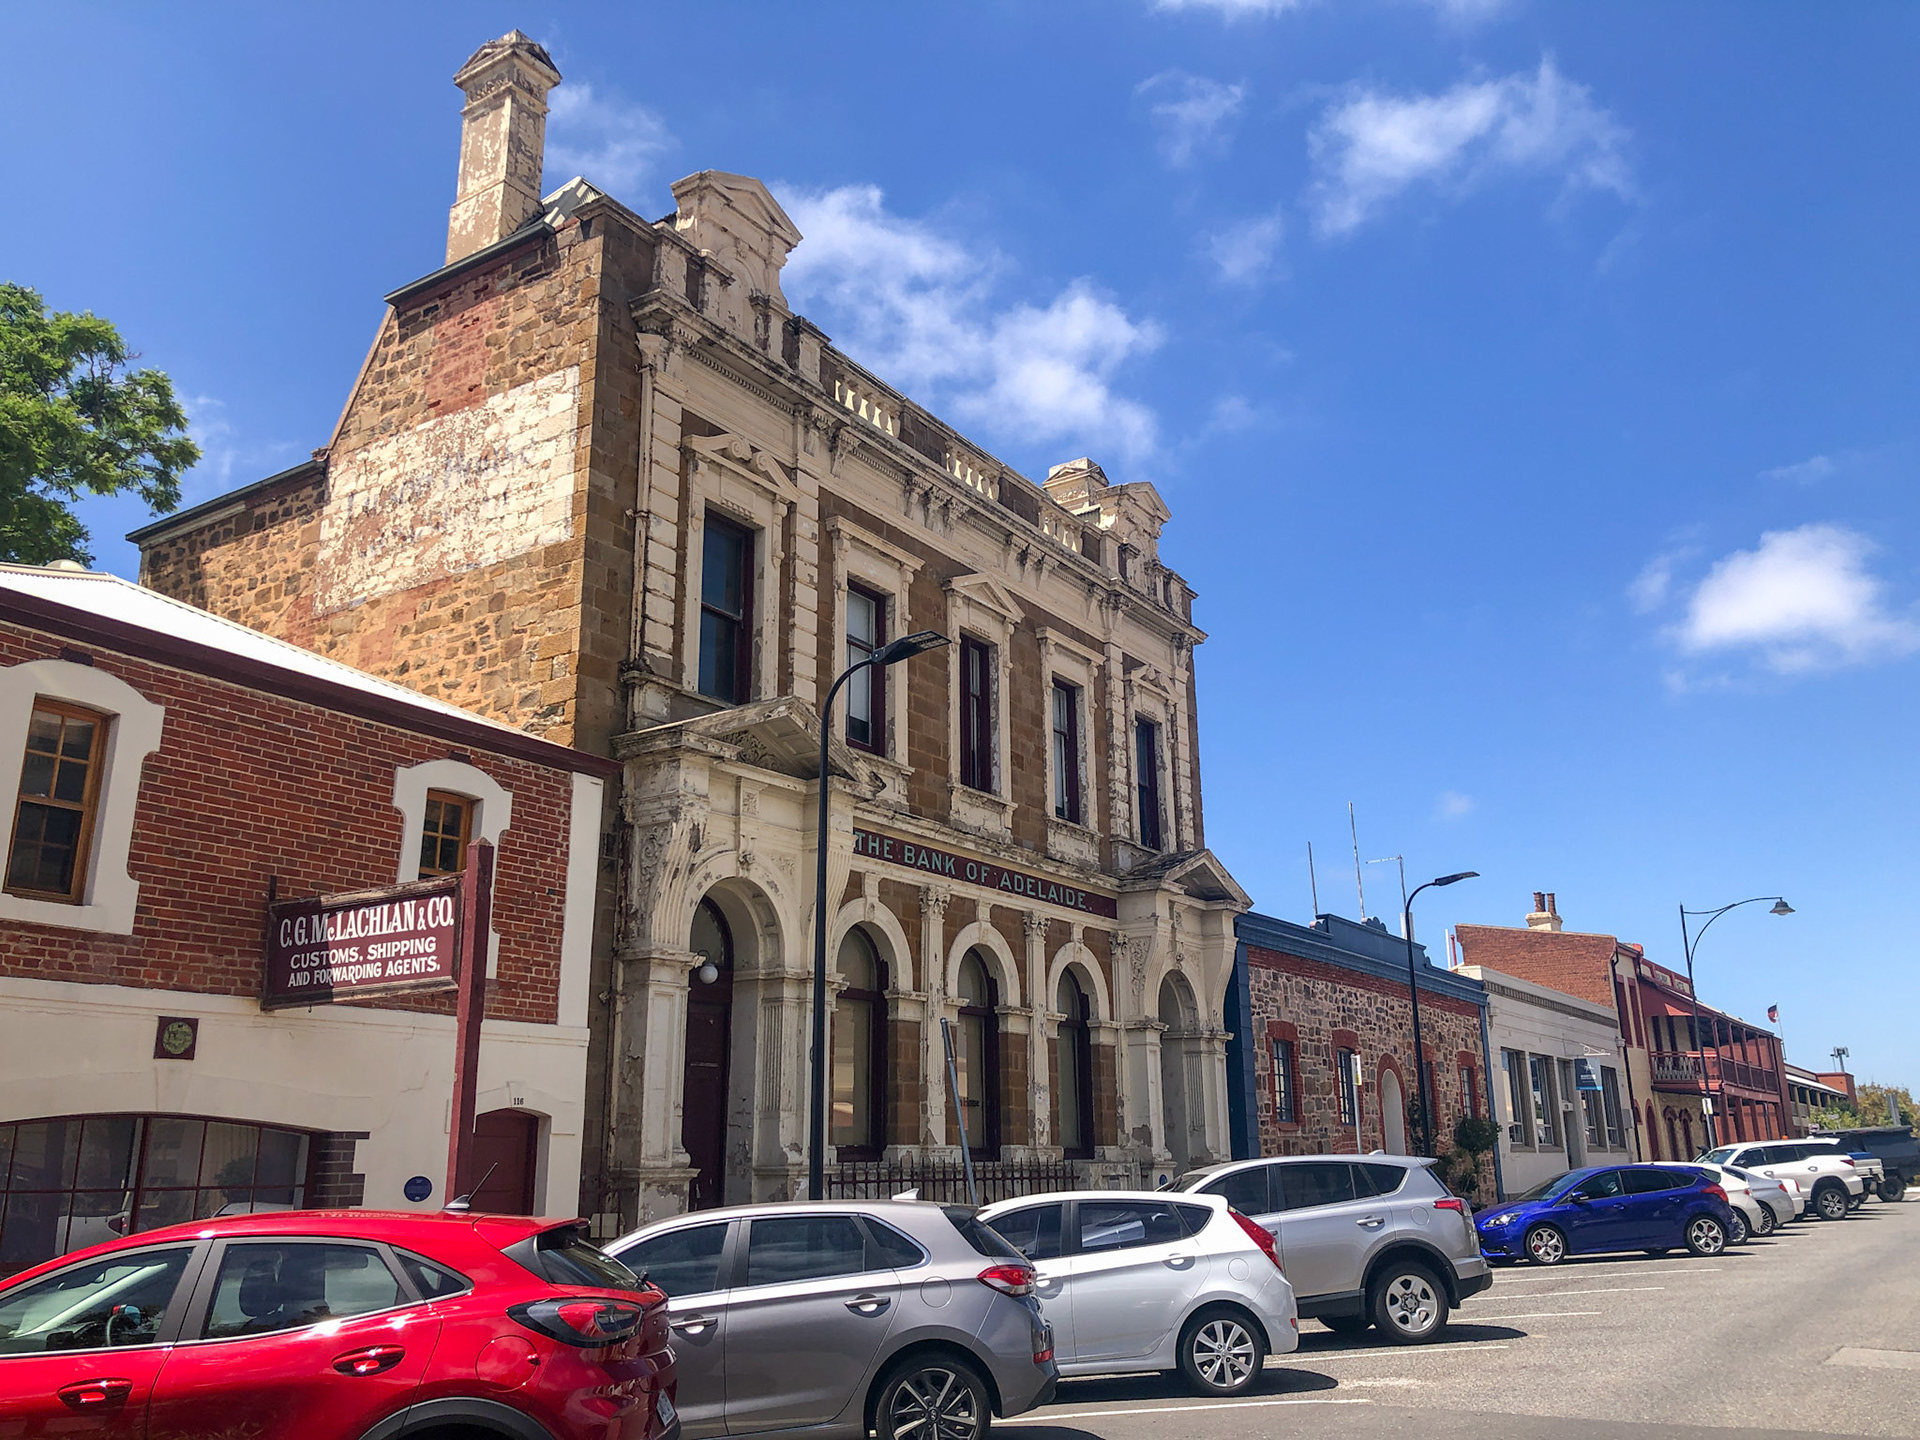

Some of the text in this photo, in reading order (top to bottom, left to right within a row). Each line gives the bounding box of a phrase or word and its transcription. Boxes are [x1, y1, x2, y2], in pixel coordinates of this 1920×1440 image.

[854, 831, 1092, 911] THE BANK OF ADELAIDE.
[417, 906, 427, 931] &
[427, 896, 454, 928] CO.
[290, 936, 436, 969] CUSTOMS, SHIPPING
[288, 955, 440, 987] AND FORWARDING AGENTS.
[513, 1097, 524, 1105] 116
